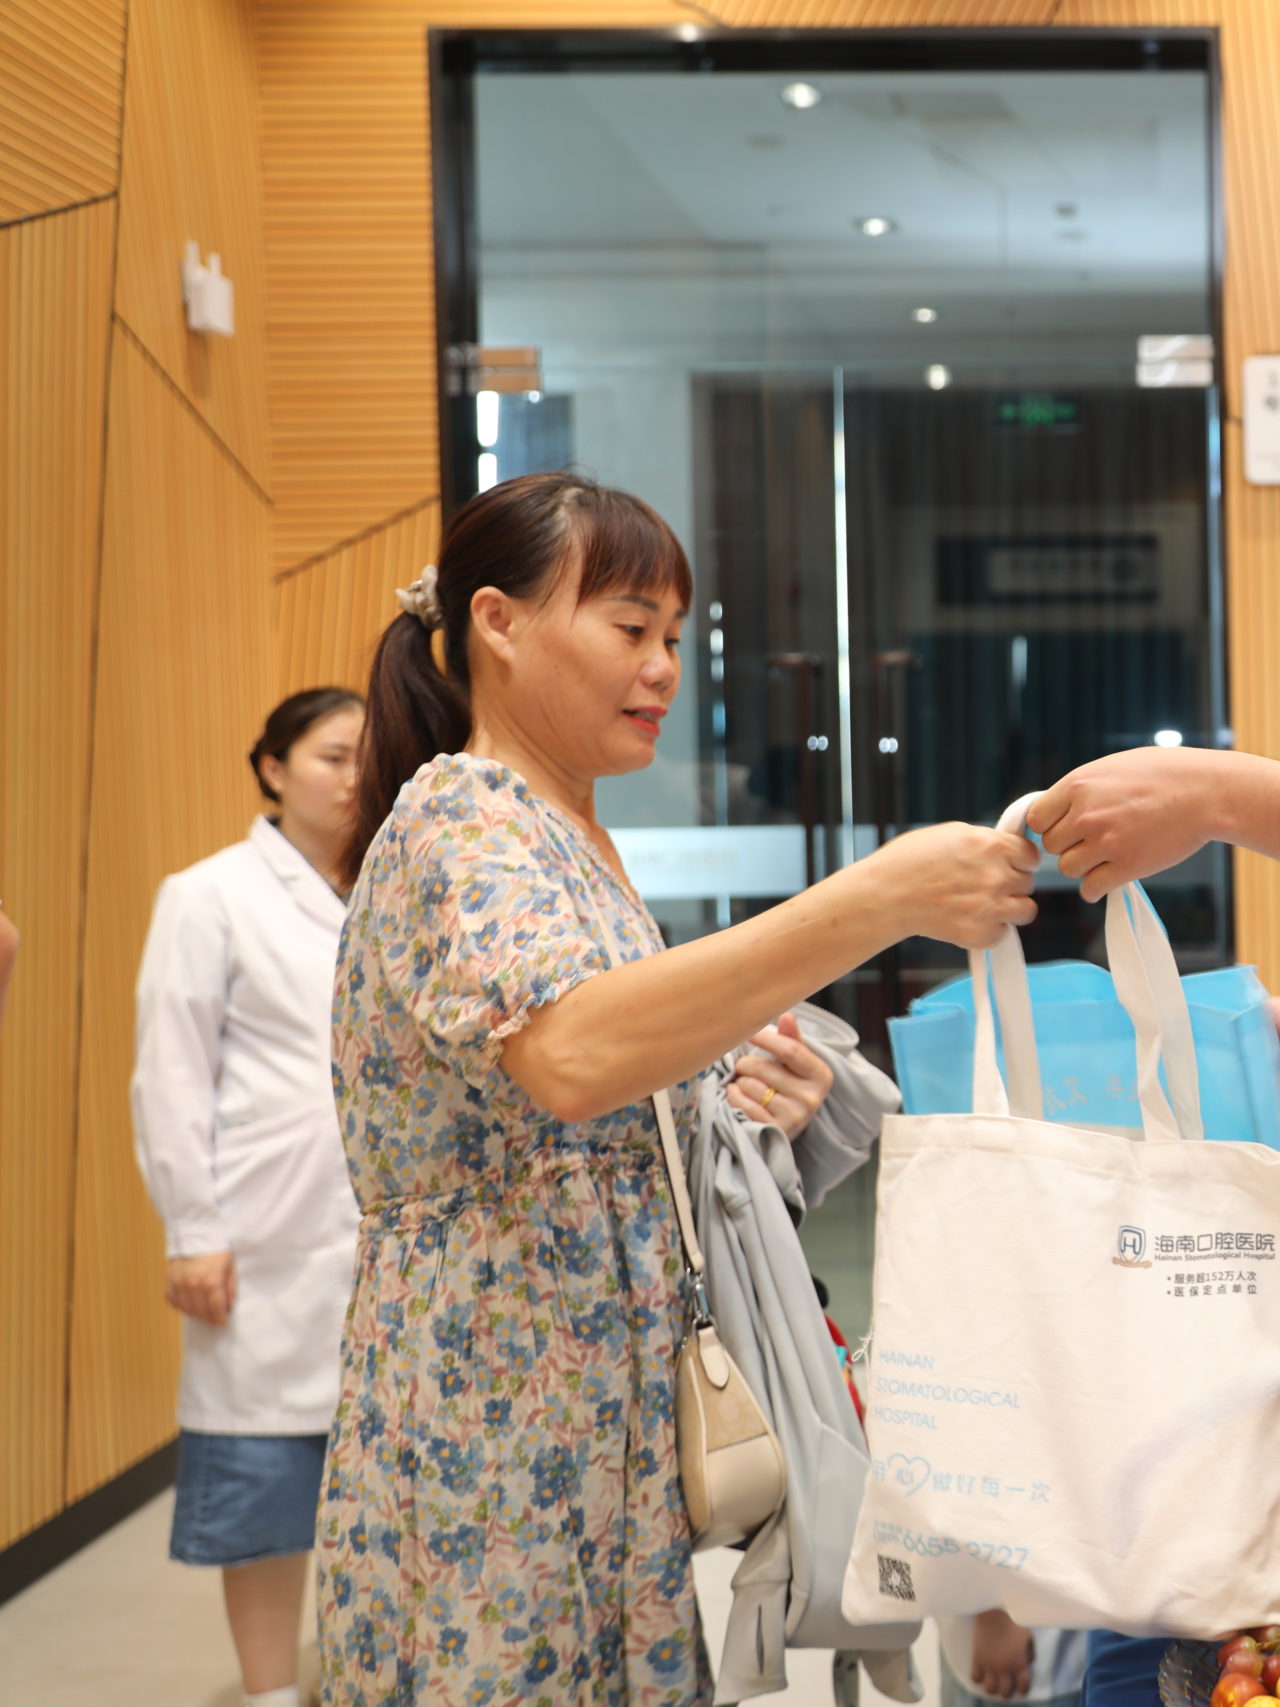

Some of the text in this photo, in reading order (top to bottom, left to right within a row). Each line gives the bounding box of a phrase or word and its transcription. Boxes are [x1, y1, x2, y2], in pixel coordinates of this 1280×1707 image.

[1154, 1232, 1275, 1253] 海南口腔医院
[1154, 1250, 1275, 1262] Hainan Stomatological Hospital
[878, 1350, 935, 1370] HAINAN
[875, 1376, 1021, 1409] STOMATOLOGICAL
[874, 1406, 939, 1430] HOSPITAL
